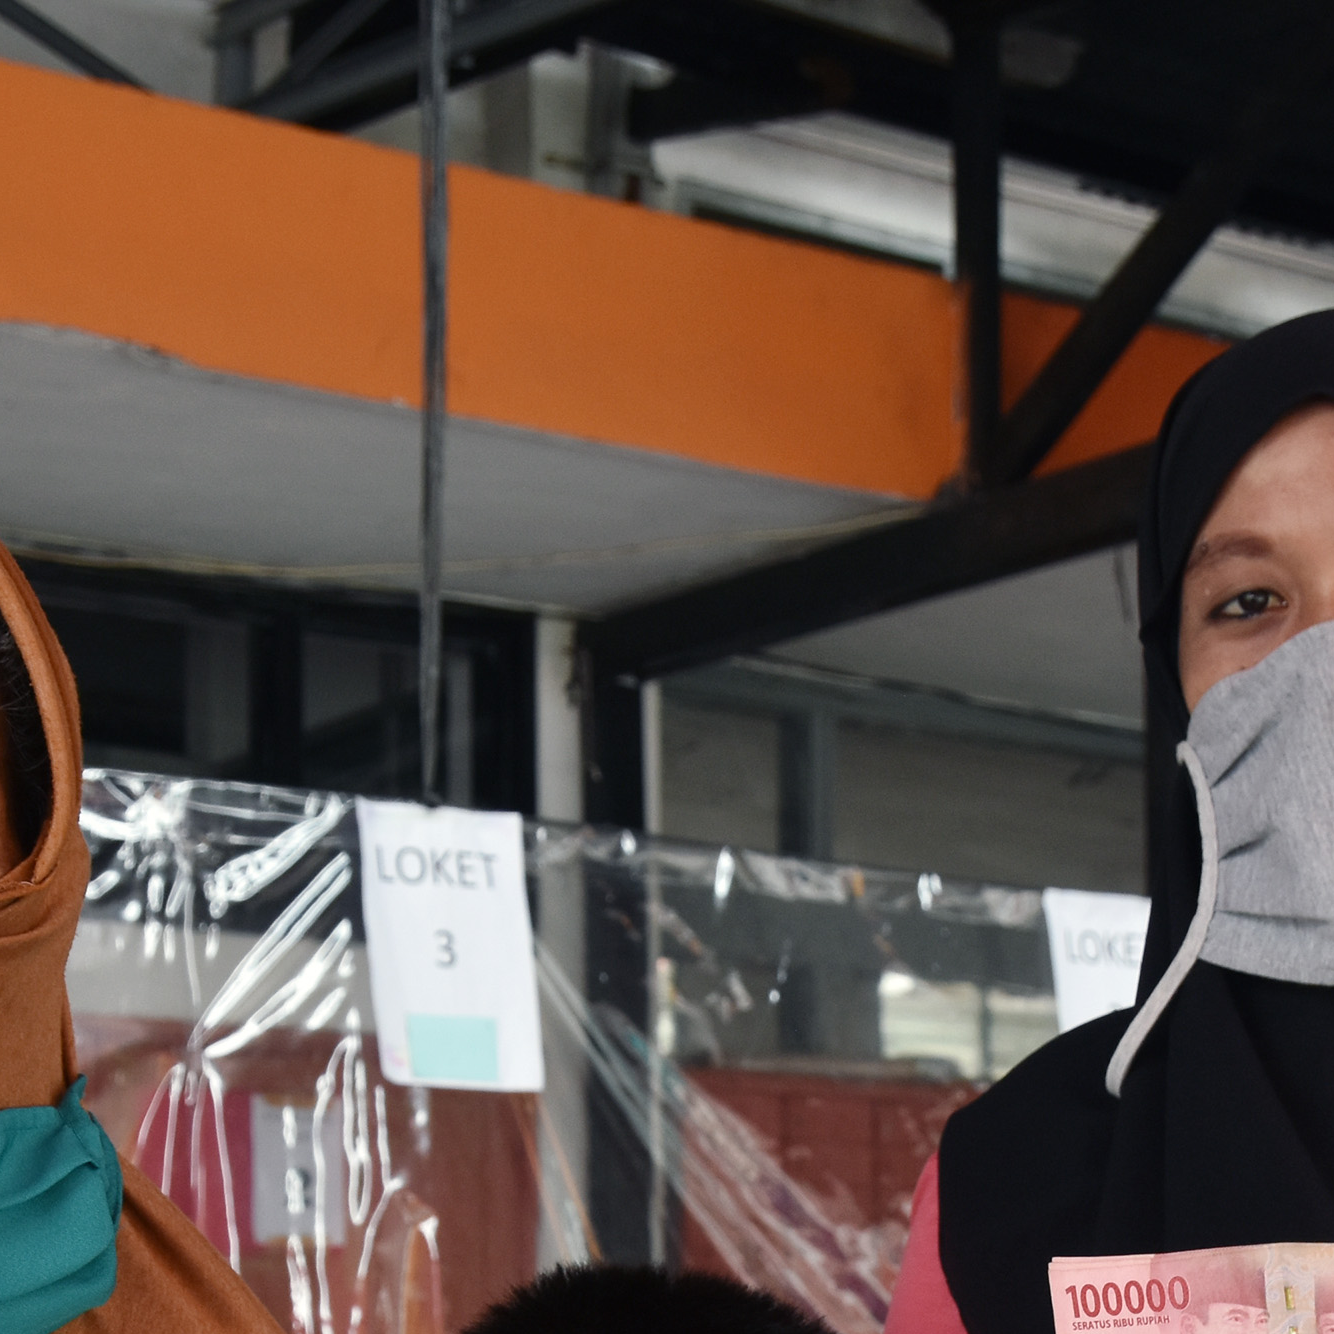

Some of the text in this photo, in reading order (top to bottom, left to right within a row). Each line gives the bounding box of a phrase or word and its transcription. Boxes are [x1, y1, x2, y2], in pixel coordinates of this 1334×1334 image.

[374, 844, 497, 890] LOKET
[433, 929, 457, 969] 3
[1063, 927, 1147, 968] LOKE
[1065, 1276, 1190, 1318] 100000
[1072, 1316, 1170, 1331] SERATUS RIBU RUPIAH
